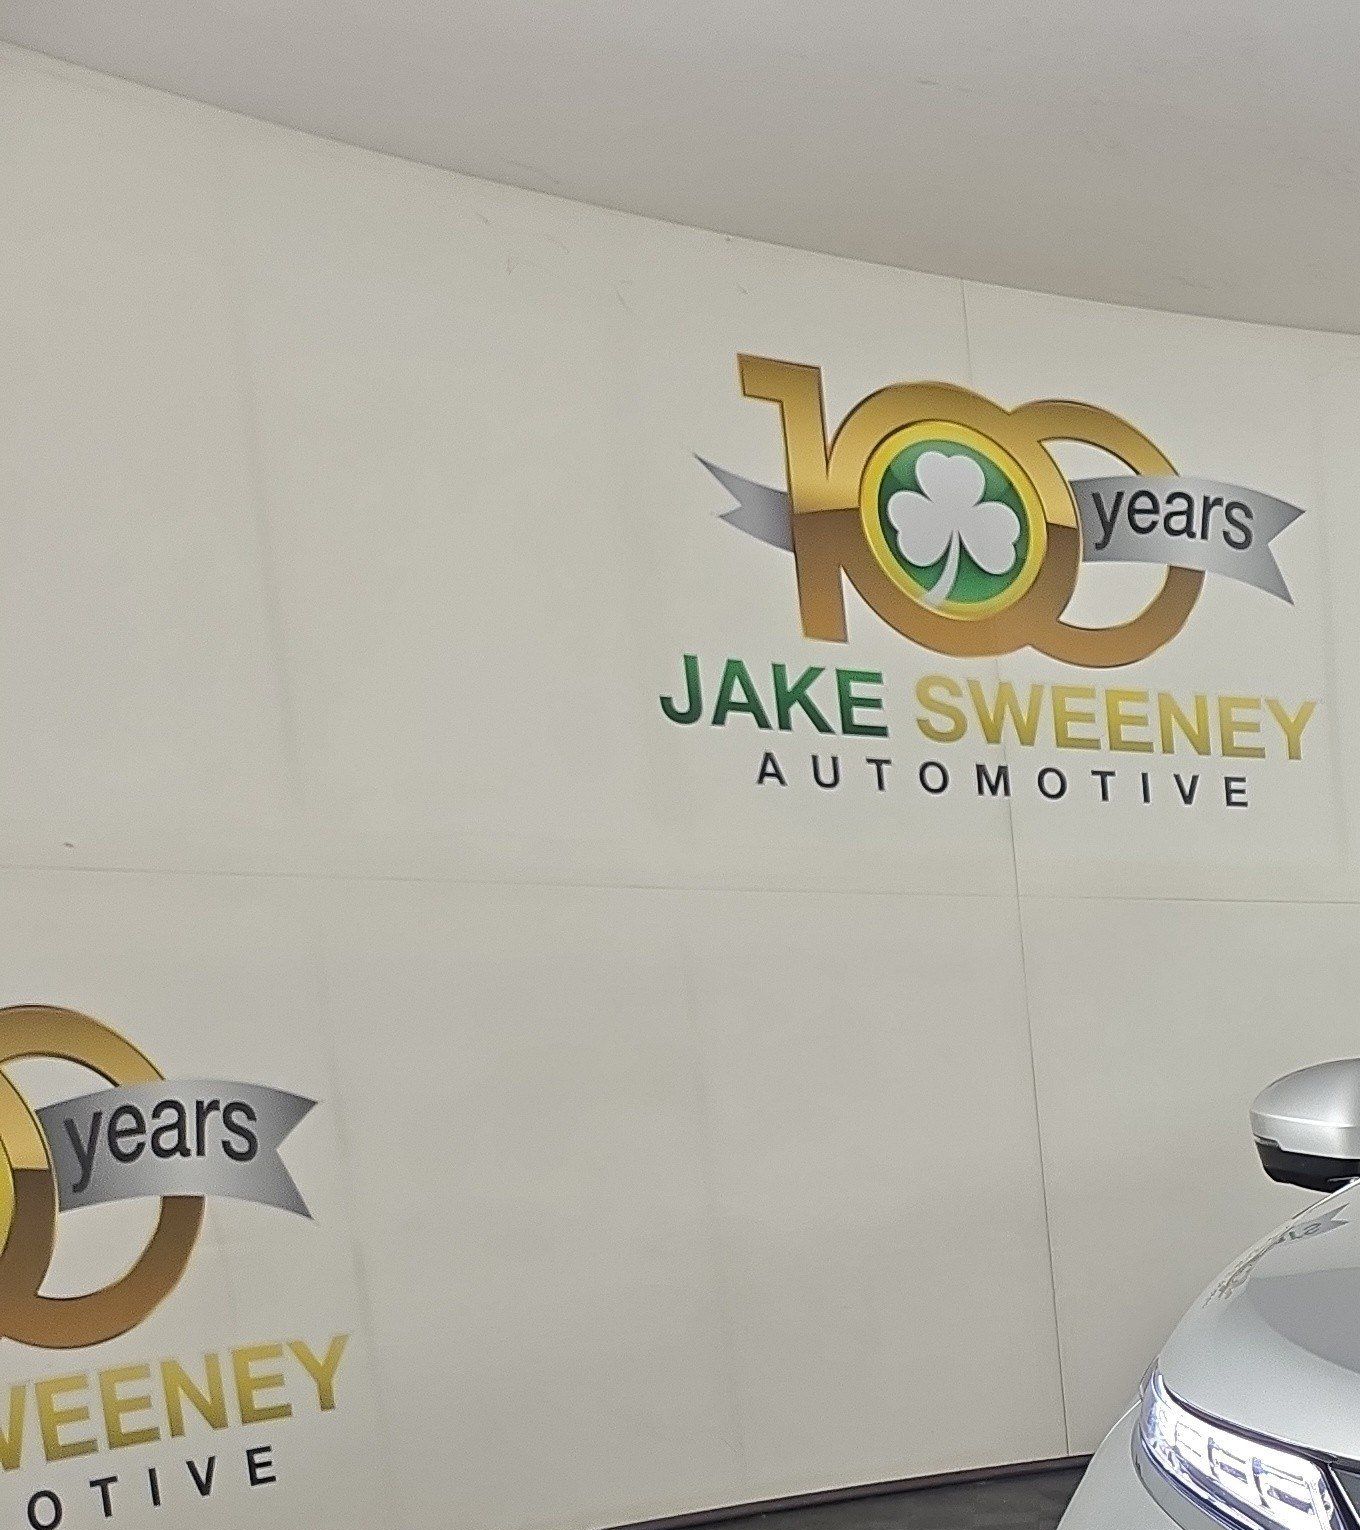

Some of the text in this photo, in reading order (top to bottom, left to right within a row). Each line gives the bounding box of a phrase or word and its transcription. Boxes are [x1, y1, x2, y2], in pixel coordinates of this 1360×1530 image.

[737, 353, 1254, 668] 100 years
[659, 653, 1317, 761] JAKE SWEENEY
[756, 752, 1249, 807] AUTOMOTIVE
[64, 1098, 258, 1193] years
[0, 1333, 349, 1473] EENEY
